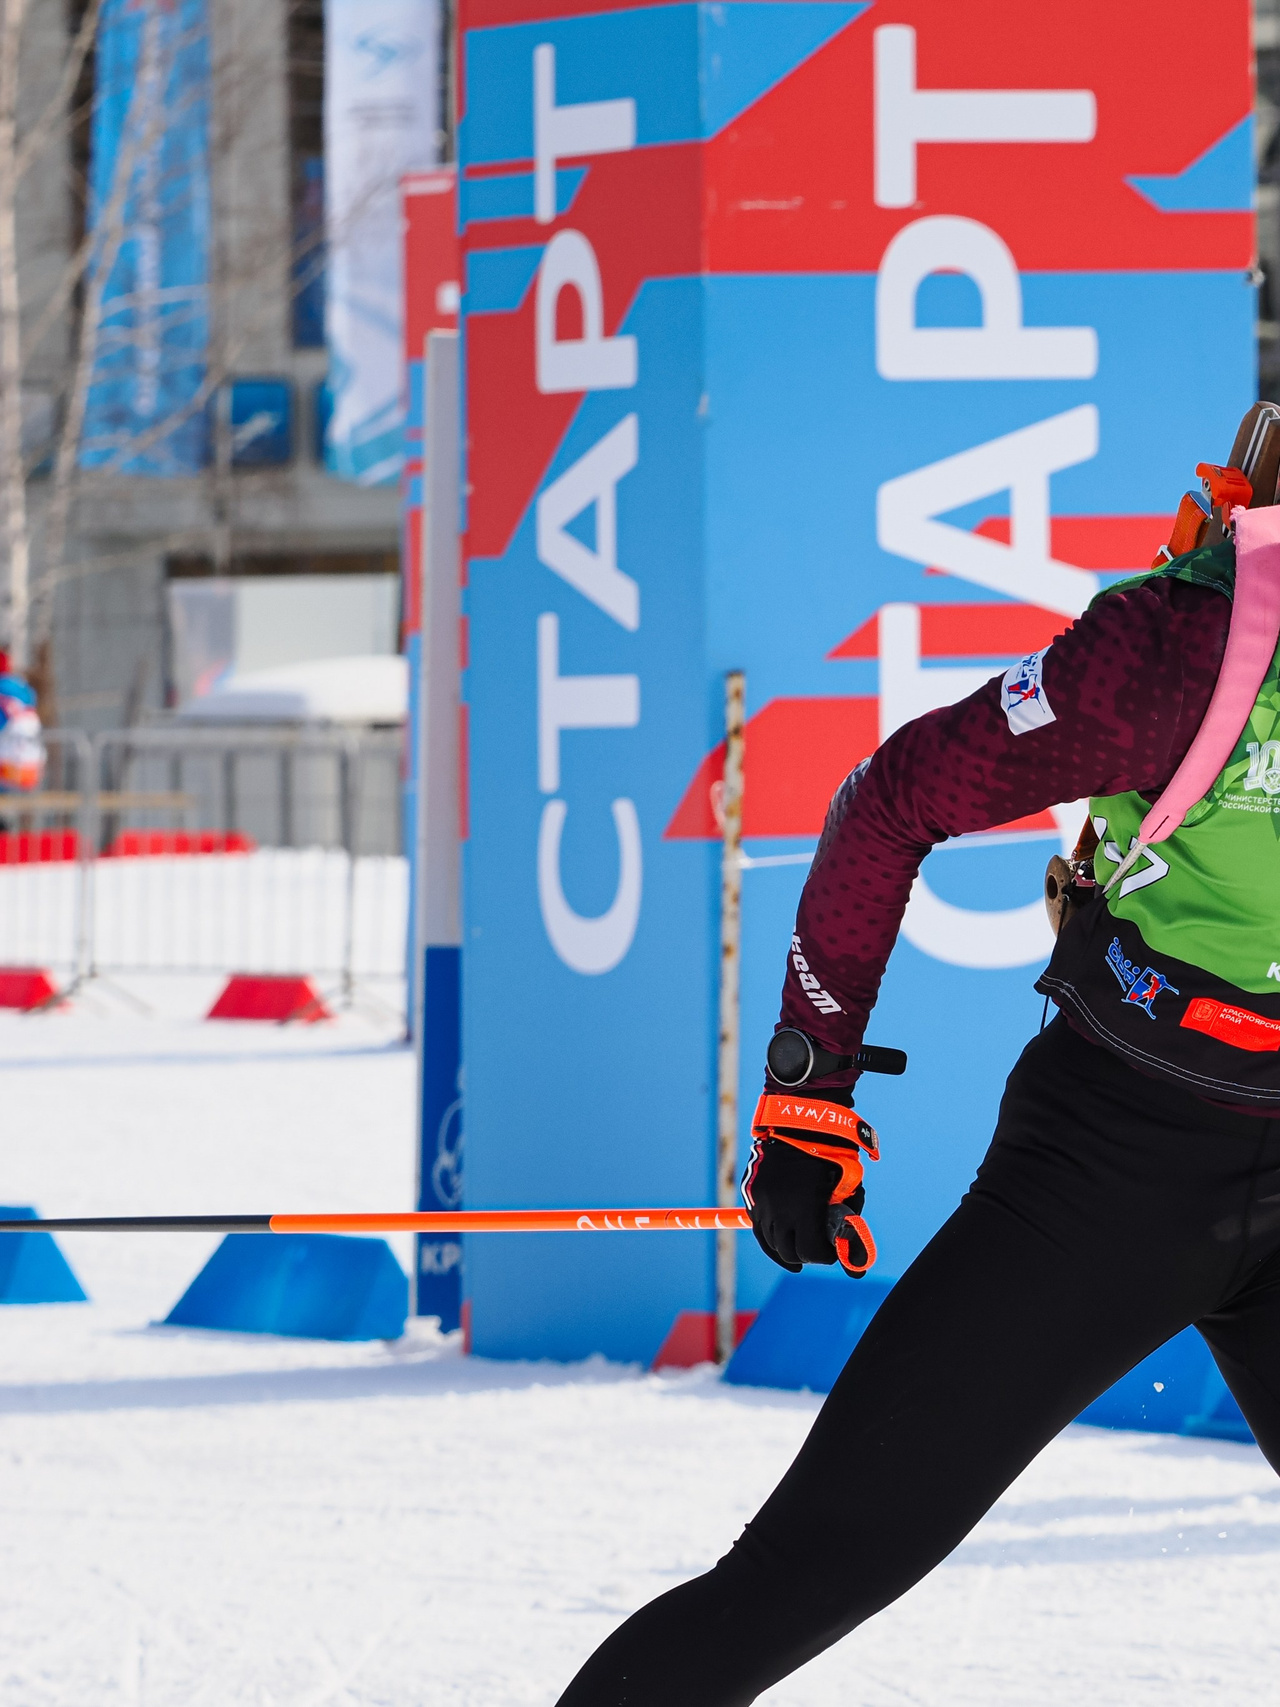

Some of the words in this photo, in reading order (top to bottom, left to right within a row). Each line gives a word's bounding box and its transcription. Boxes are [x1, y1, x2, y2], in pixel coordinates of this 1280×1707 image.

[534, 43, 642, 976] СТАРТ
[1217, 799, 1272, 814] РОССИЙСКОЙ
[1219, 1012, 1243, 1026] КРАЙ
